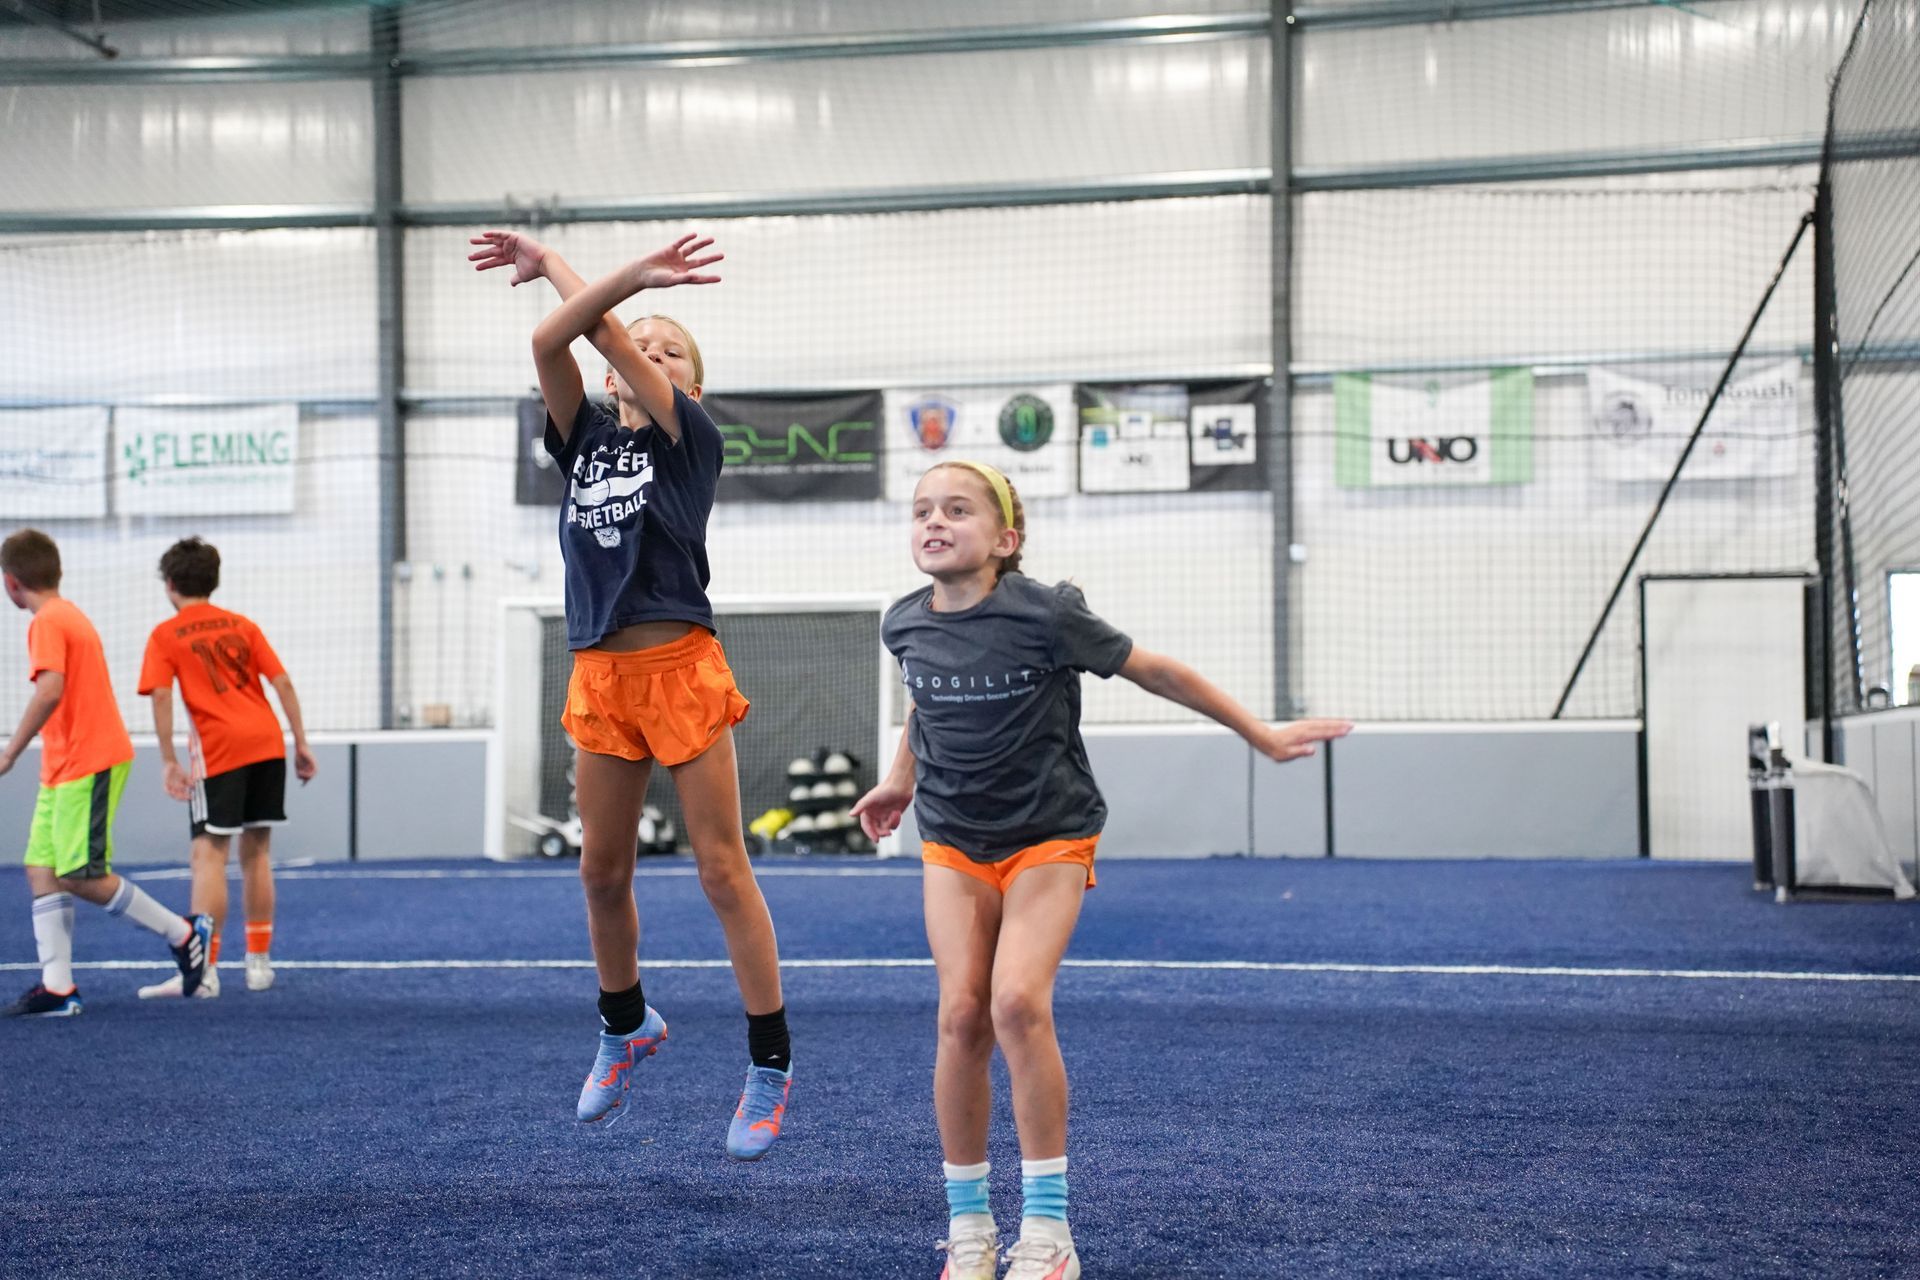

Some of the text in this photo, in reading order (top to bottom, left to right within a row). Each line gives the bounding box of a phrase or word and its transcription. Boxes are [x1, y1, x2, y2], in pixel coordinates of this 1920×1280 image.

[153, 431, 290, 467] FLEMING
[1387, 436, 1478, 463] UNO
[573, 452, 648, 483] BUTER
[191, 634, 250, 694] 19
[915, 669, 1053, 689] SOGILIT
[931, 694, 964, 703] Technology
[965, 693, 986, 702] Driven
